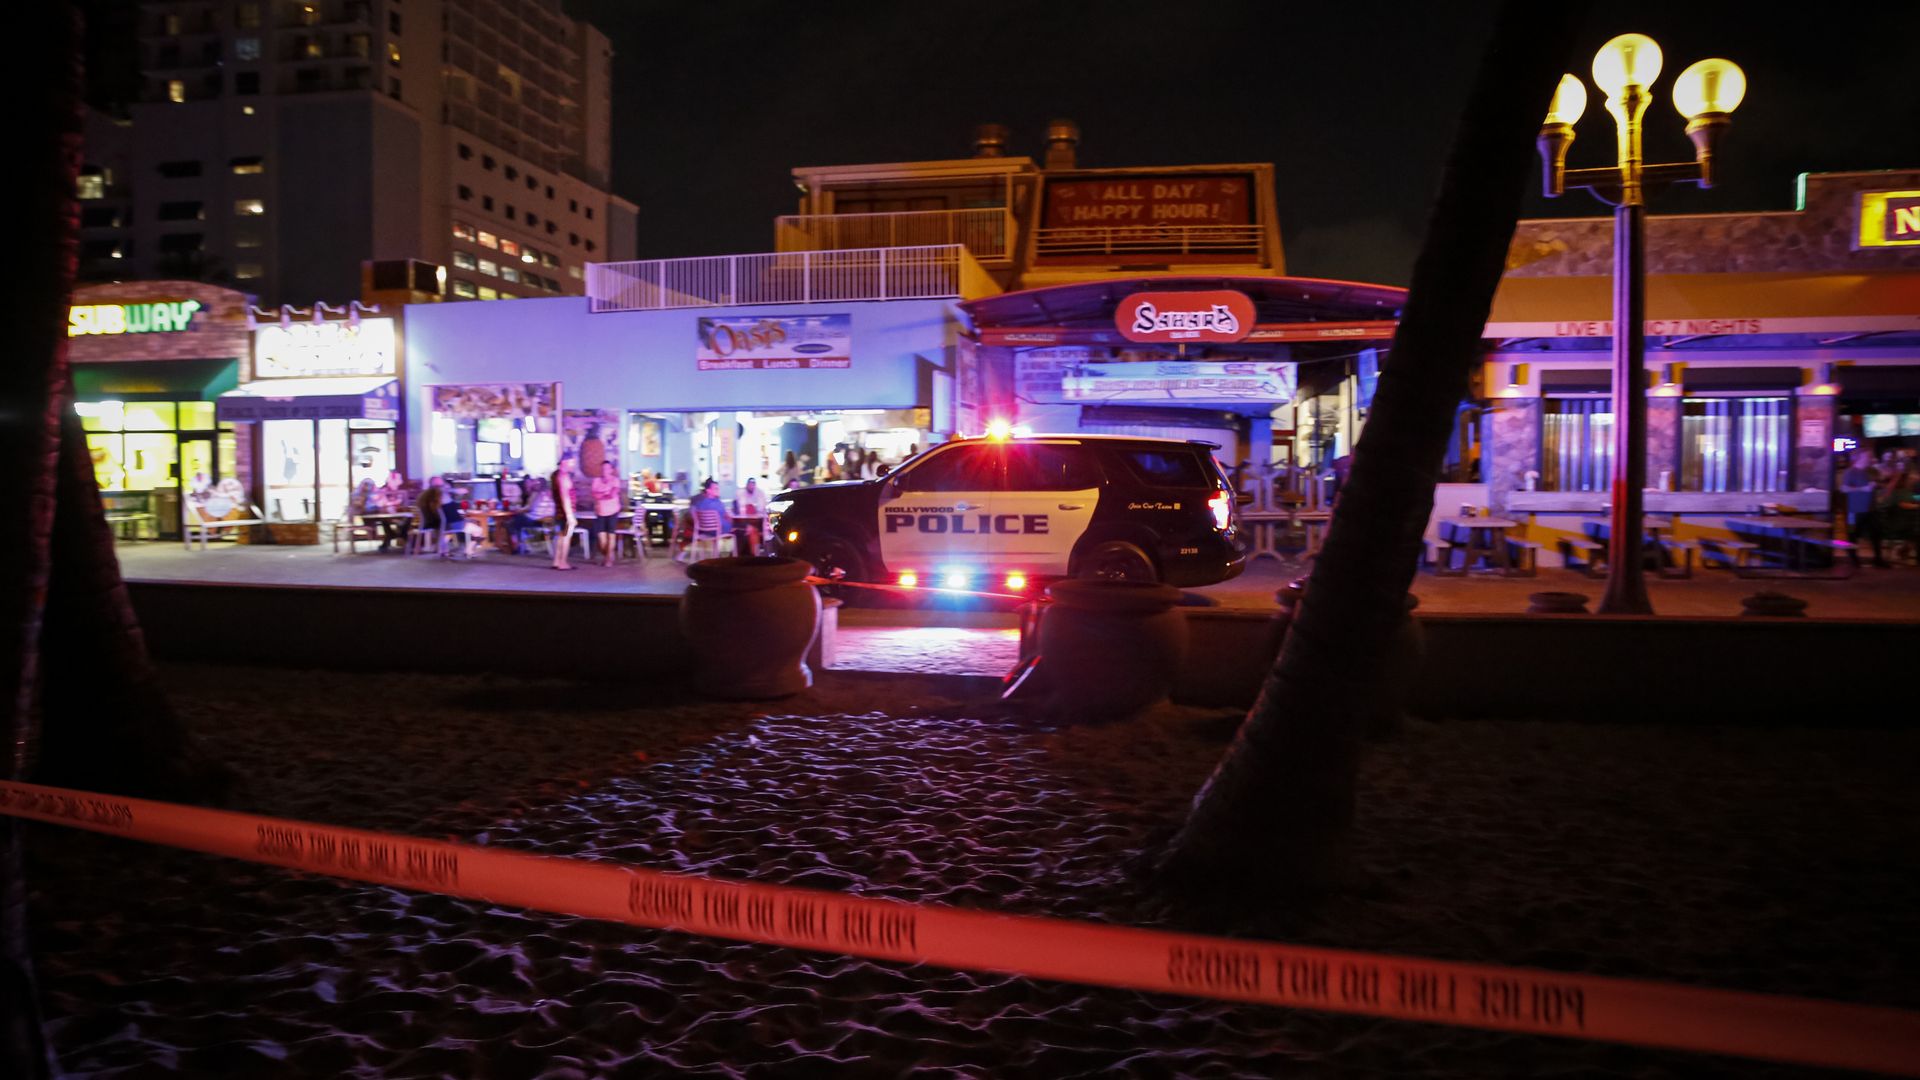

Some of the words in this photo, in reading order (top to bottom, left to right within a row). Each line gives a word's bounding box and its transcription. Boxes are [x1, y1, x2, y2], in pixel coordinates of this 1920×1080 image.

[1102, 184, 1144, 199] ALL
[1154, 184, 1195, 199] DAY
[1073, 204, 1144, 220] HAPPY
[1152, 203, 1220, 219] HOUR!
[68, 299, 201, 337] SUBWAY
[1556, 321, 1597, 336] LIVE
[1603, 321, 1664, 335] MIC
[1671, 320, 1681, 335] 7
[1687, 319, 1761, 334] NIGHTS
[710, 319, 786, 357] Oasis
[885, 514, 1049, 534] POLICE
